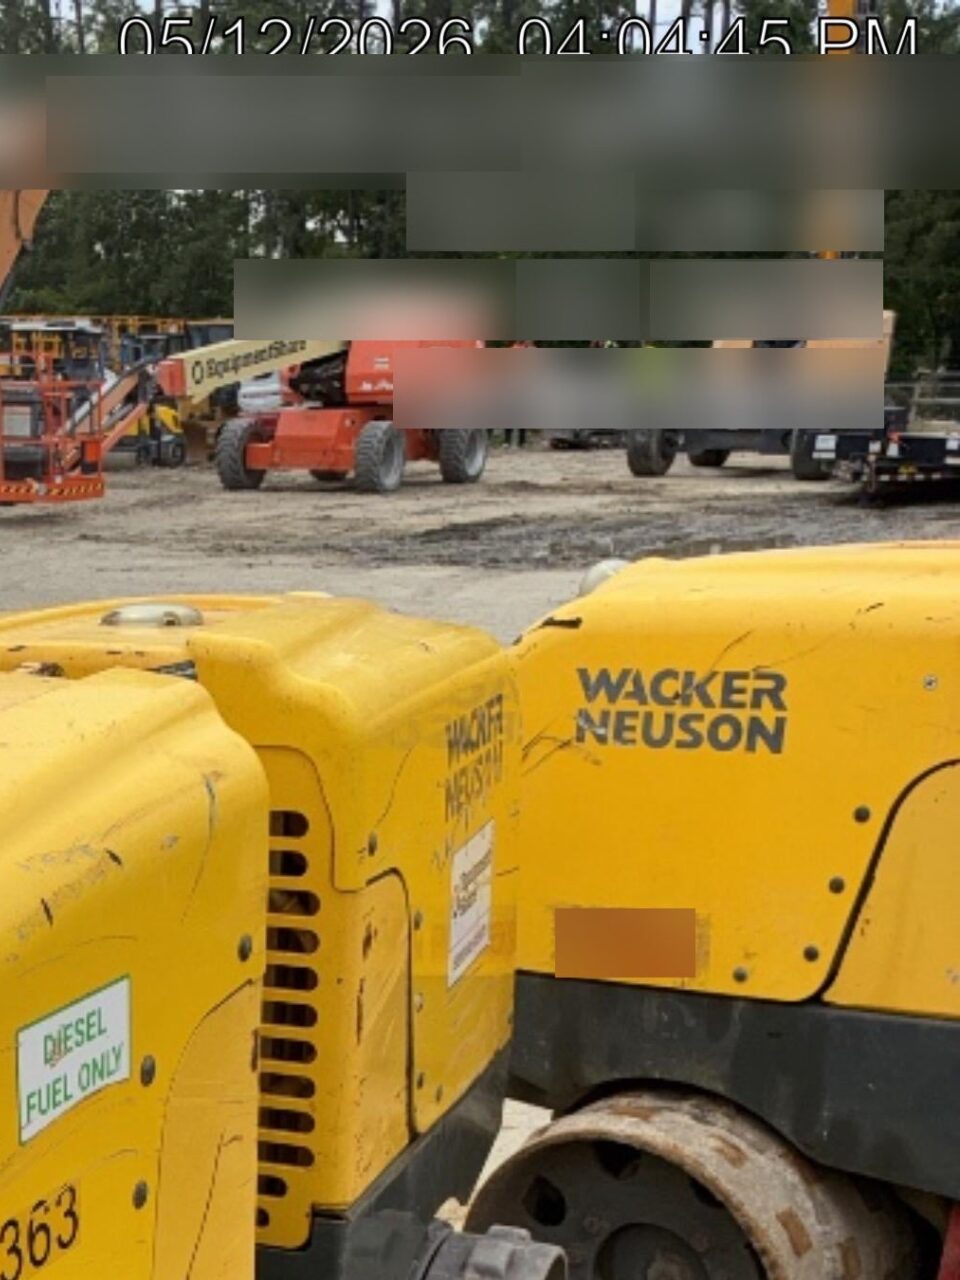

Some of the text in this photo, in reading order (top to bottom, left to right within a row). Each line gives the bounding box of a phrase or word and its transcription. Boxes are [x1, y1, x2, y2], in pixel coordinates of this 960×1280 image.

[576, 667, 788, 711] WACKER
[575, 708, 787, 754] NEUSON
[43, 1007, 107, 1069] DIESEL
[26, 1042, 124, 1124] FUEL ONLY
